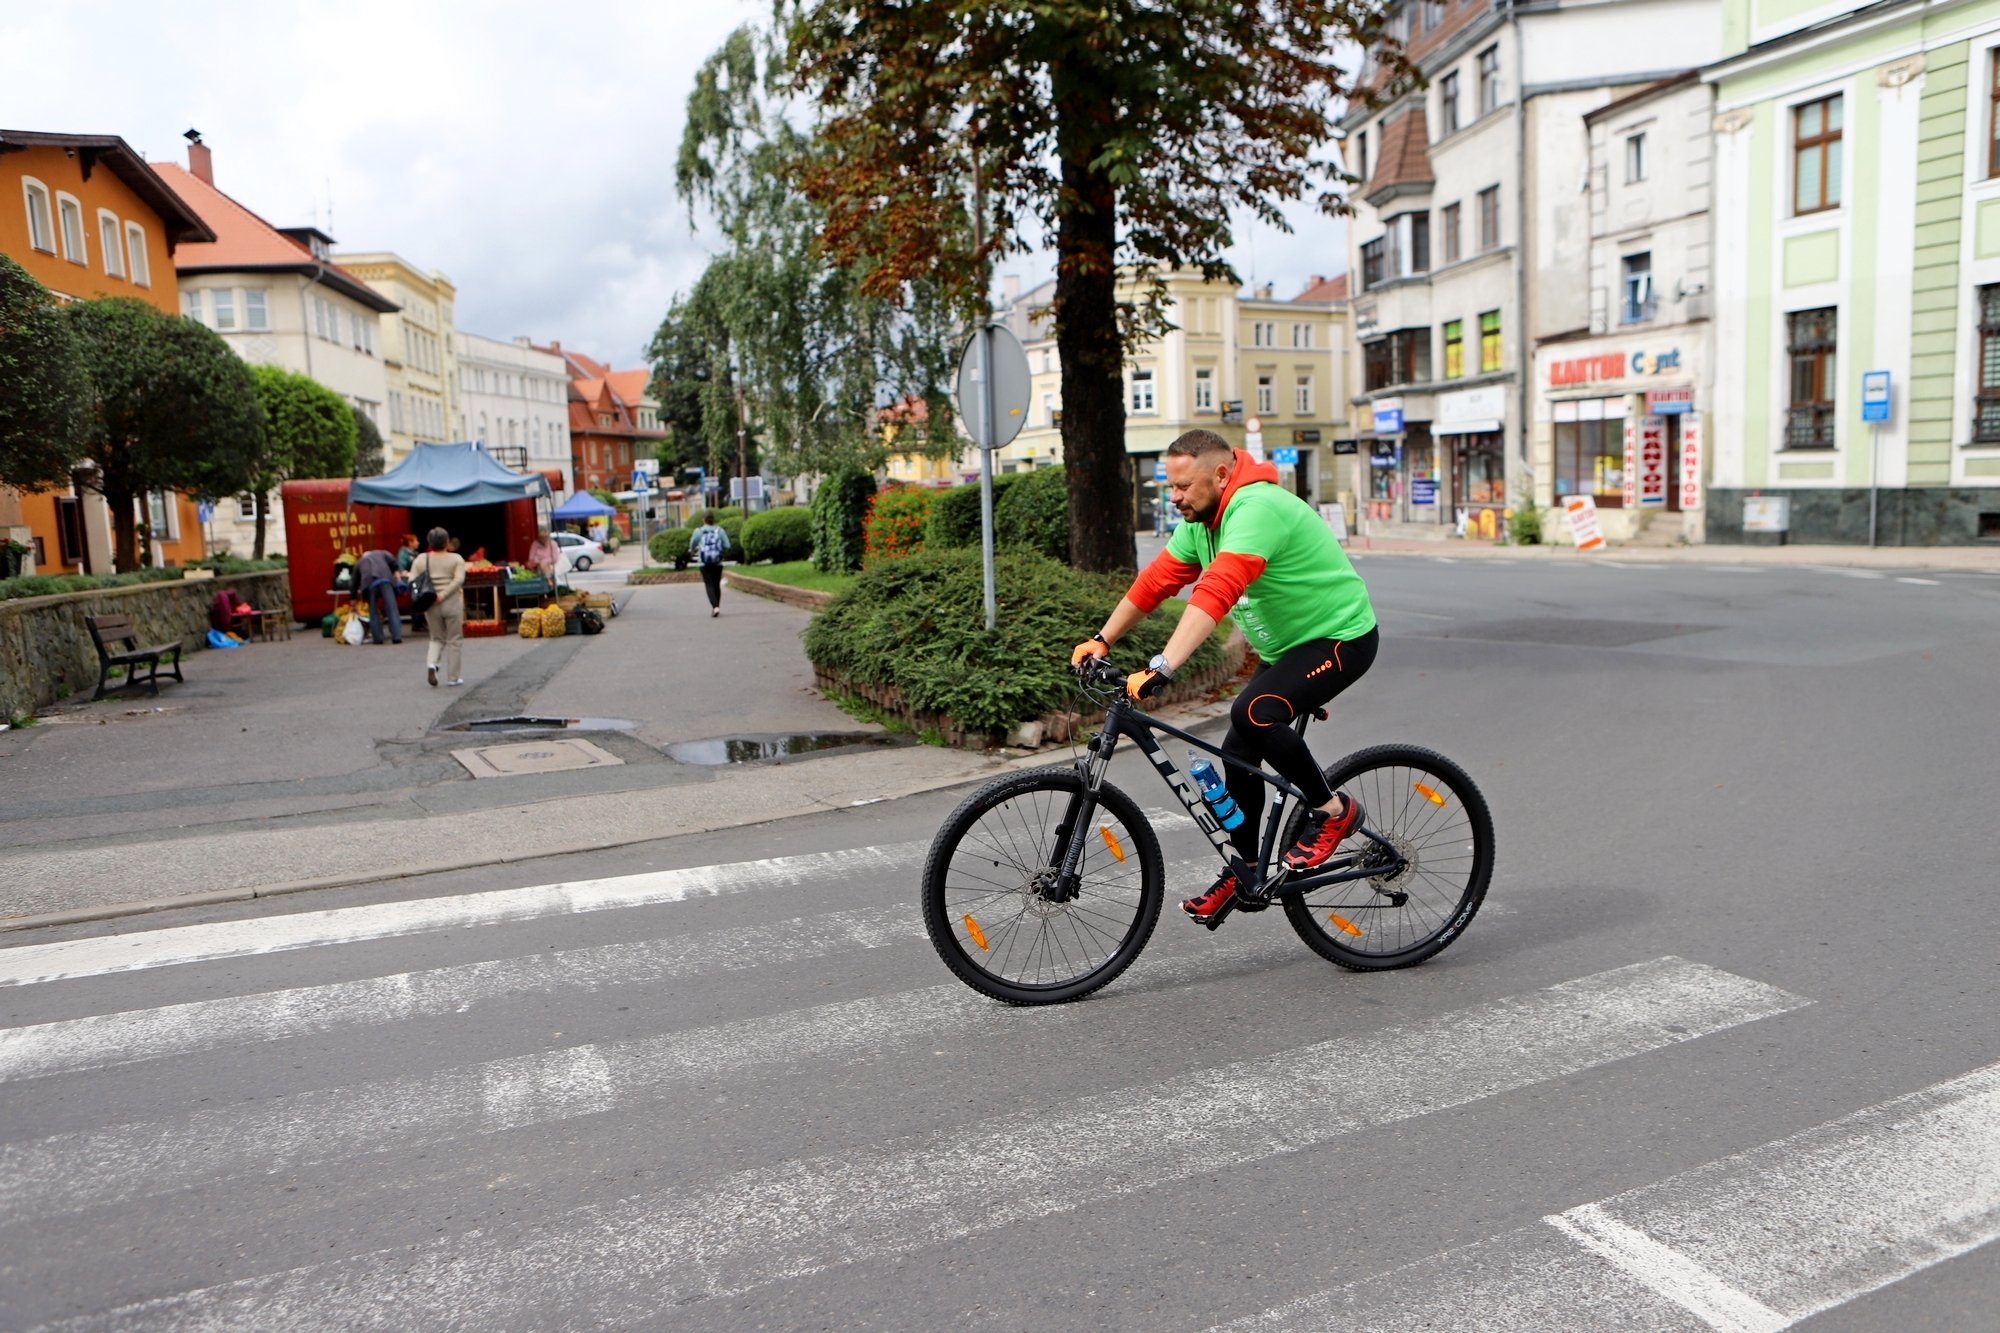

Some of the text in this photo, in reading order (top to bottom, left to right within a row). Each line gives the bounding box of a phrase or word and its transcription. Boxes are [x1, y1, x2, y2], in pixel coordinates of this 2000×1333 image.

[1550, 352, 1625, 385] KANTOR
[1643, 430, 1662, 494] KANTOR
[1684, 430, 1697, 507] KANTOR
[298, 511, 358, 525] WARZYWA
[1149, 727, 1244, 866] TREK
[1437, 901, 1473, 945] XR2 COMP
